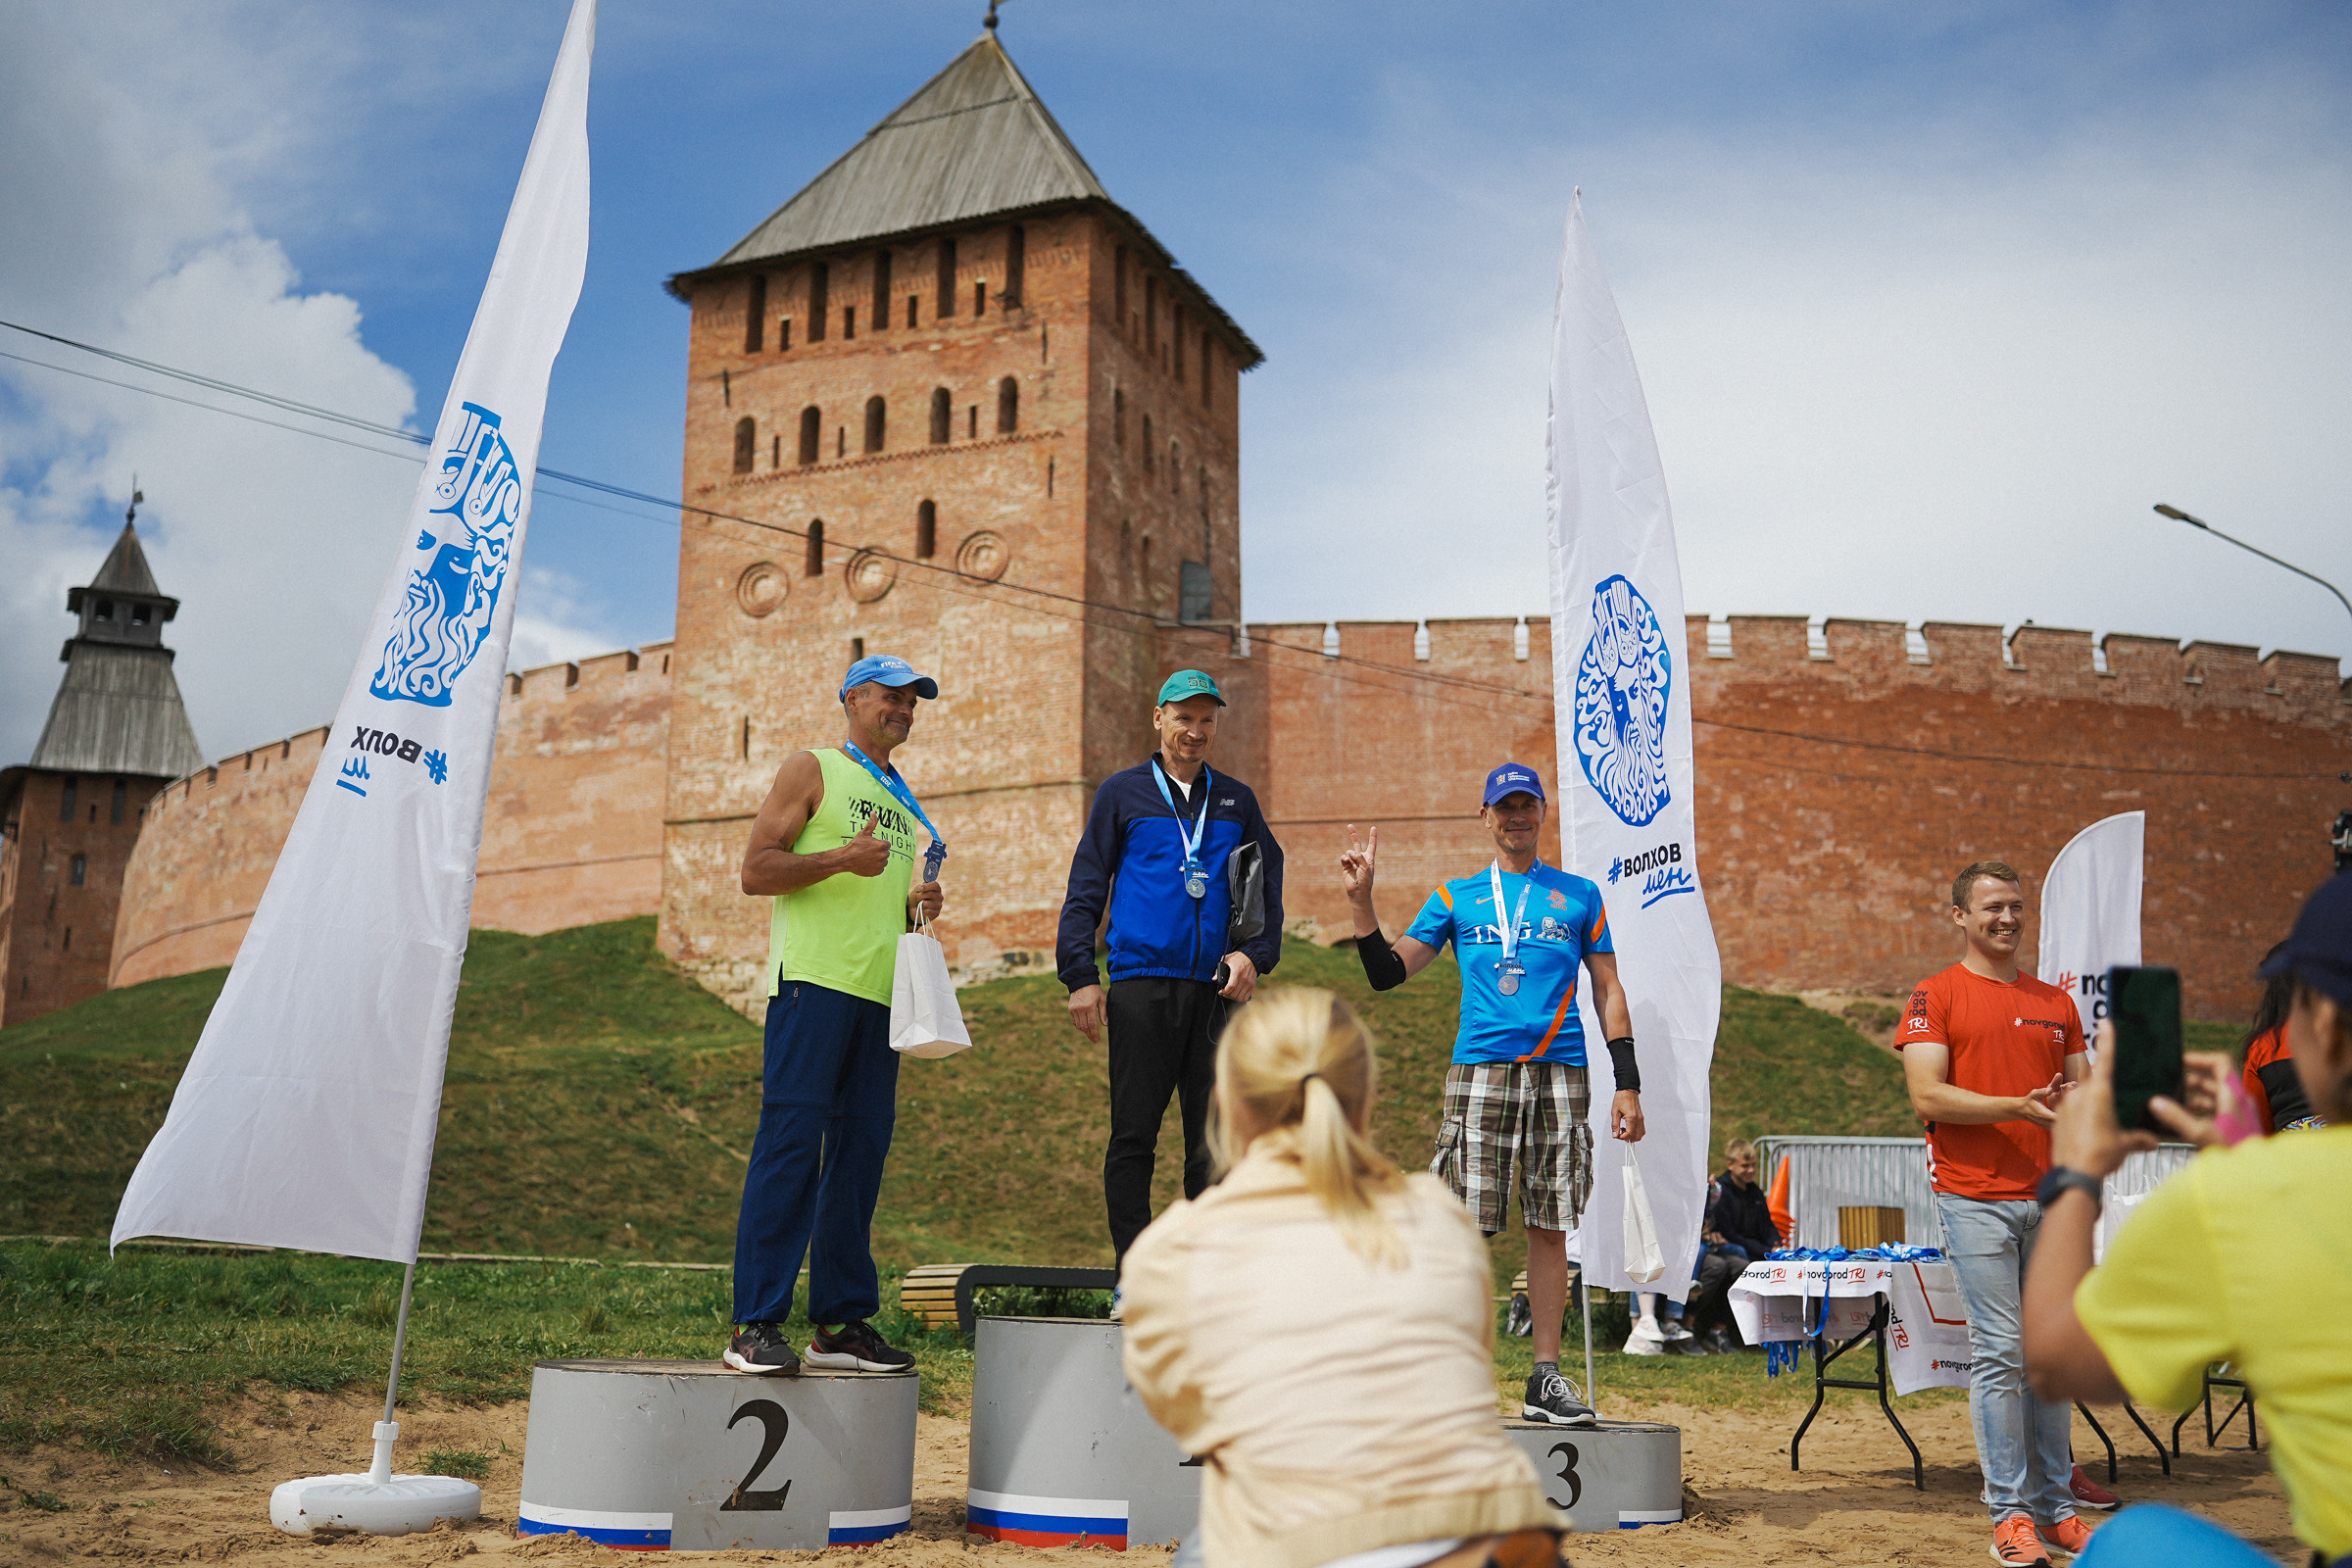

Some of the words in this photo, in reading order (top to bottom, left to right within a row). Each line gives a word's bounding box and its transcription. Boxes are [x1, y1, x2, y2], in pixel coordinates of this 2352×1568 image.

[1607, 843, 1682, 885] #ВОЛХОВ
[1908, 1005, 1927, 1016] rod
[1912, 998, 1927, 1008] go
[719, 1398, 792, 1511] 2
[1545, 1442, 1582, 1511] 3
